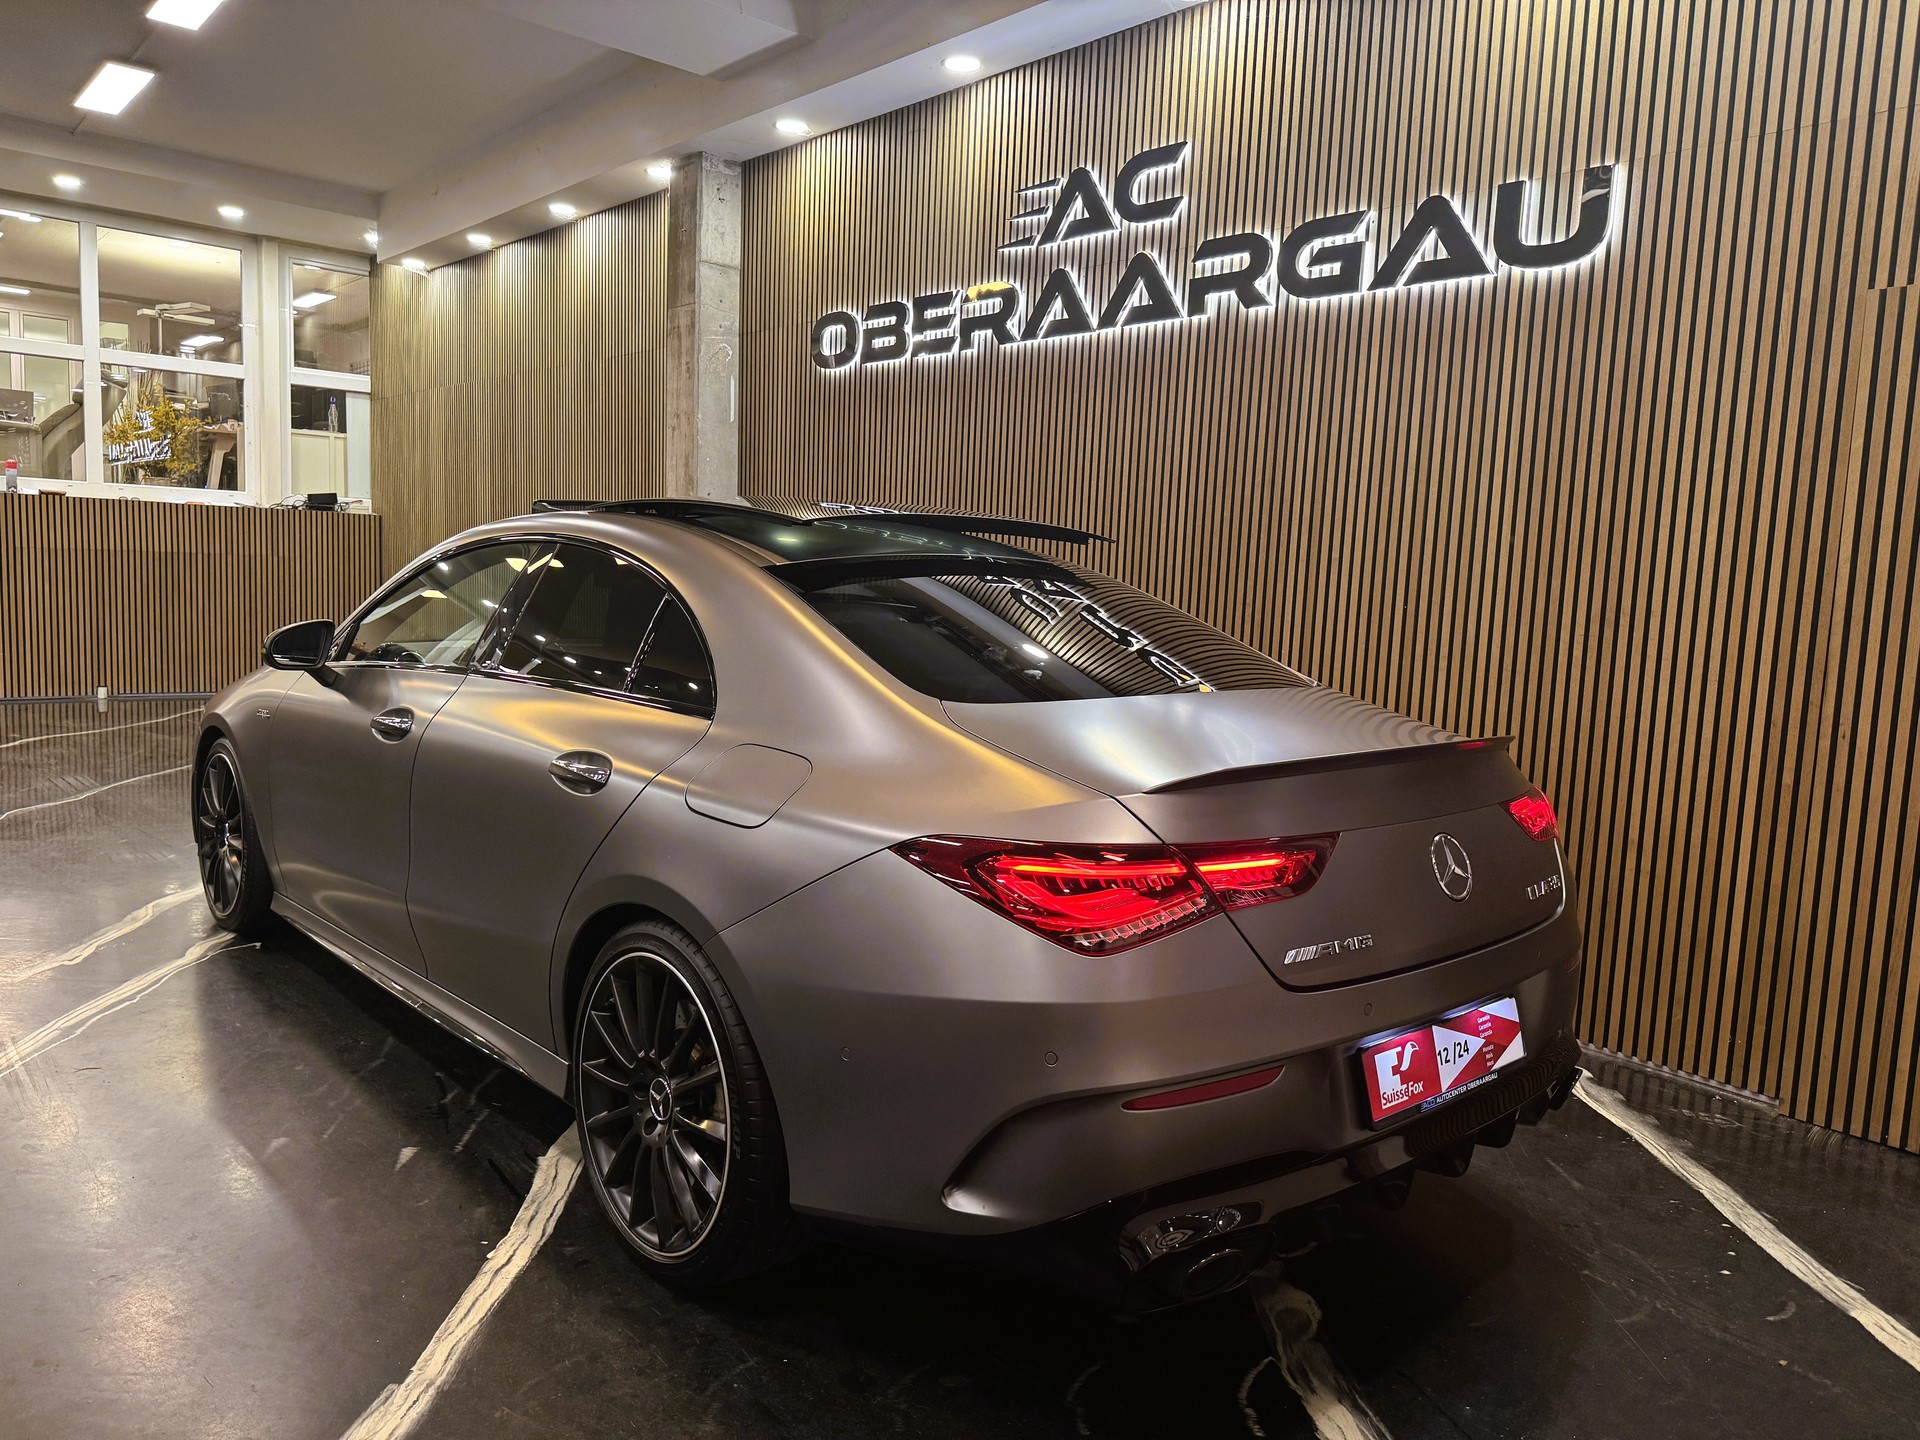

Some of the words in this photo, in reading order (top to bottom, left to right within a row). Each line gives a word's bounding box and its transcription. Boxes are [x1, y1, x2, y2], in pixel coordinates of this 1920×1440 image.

[810, 163, 1620, 373] OBERAARGAU
[1382, 1081, 1424, 1107] SuisseFox
[1436, 1085, 1467, 1103] AUTOCENTER
[1467, 1072, 1498, 1090] OBERAARGAU
